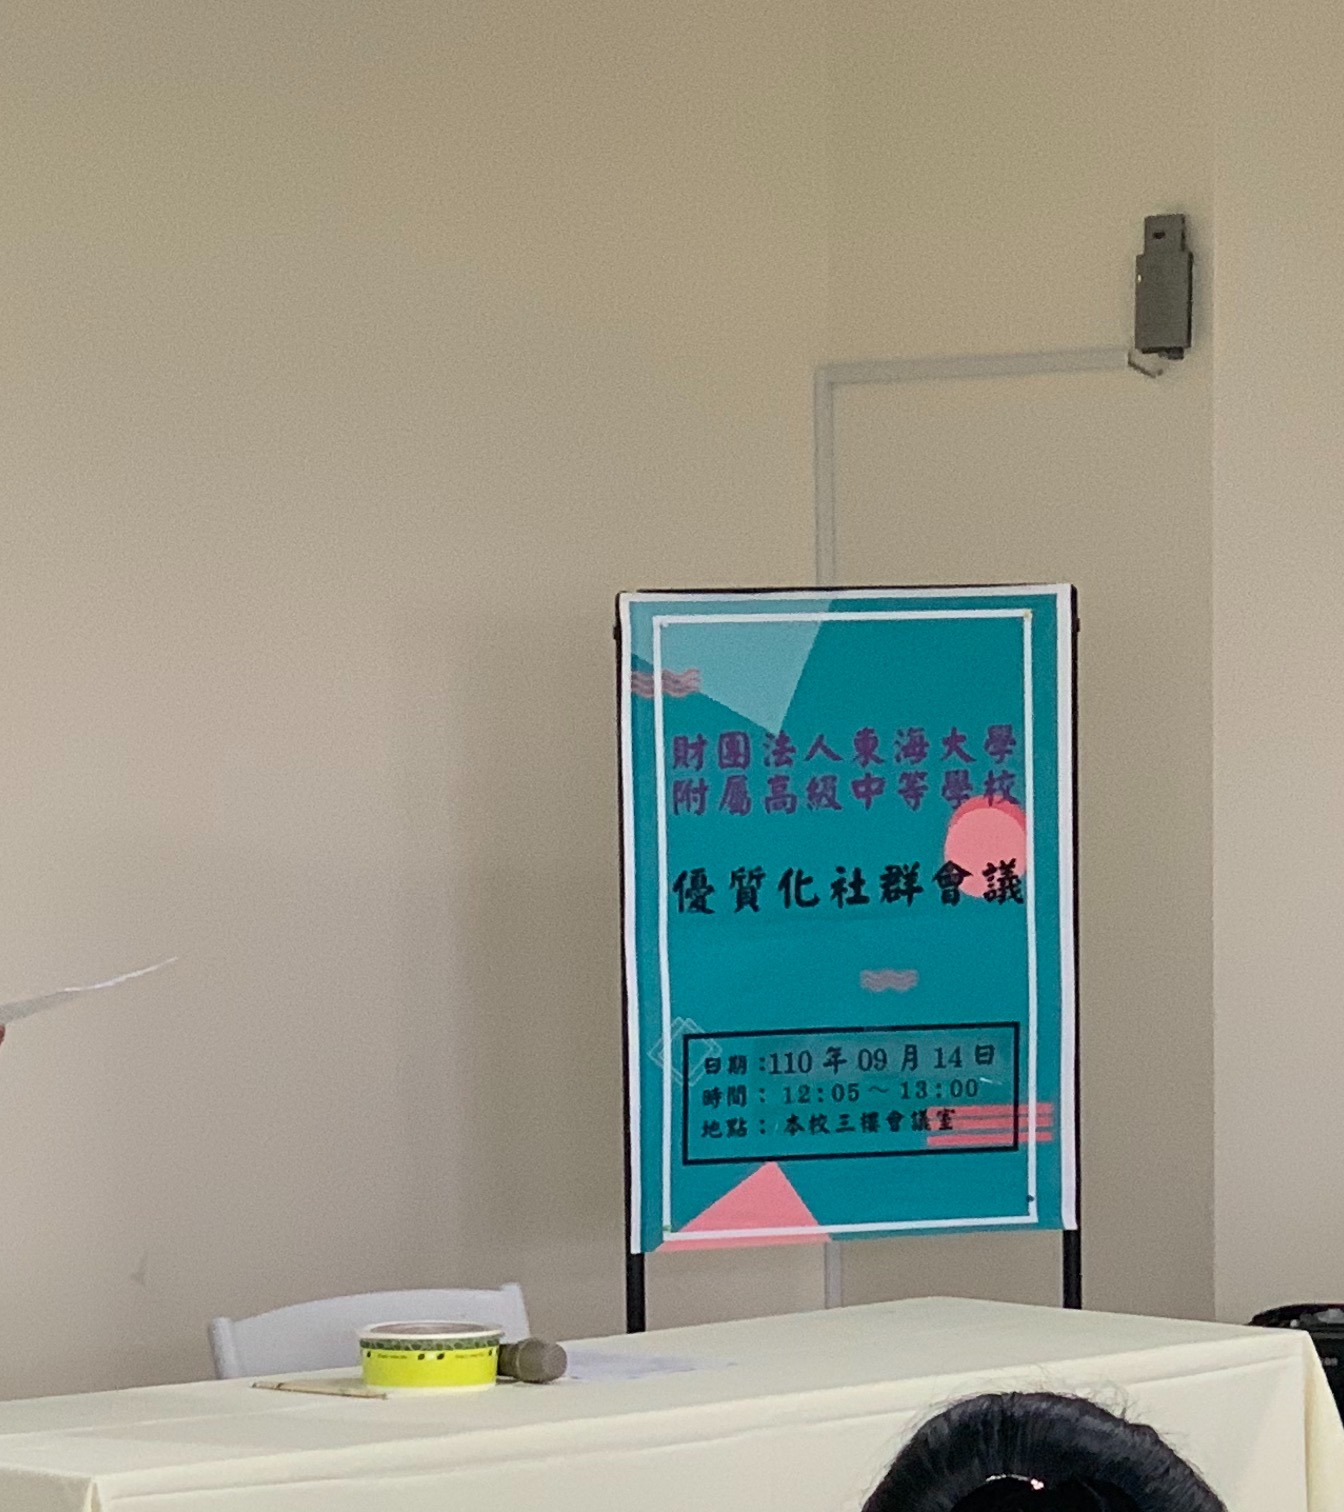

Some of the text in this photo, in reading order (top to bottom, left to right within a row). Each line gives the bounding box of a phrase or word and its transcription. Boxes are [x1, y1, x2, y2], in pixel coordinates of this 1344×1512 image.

[672, 724, 1017, 771] 財團法人東海大學
[672, 768, 1020, 817] 附屬高級中等學校
[672, 857, 1025, 915] 優質化社群會議
